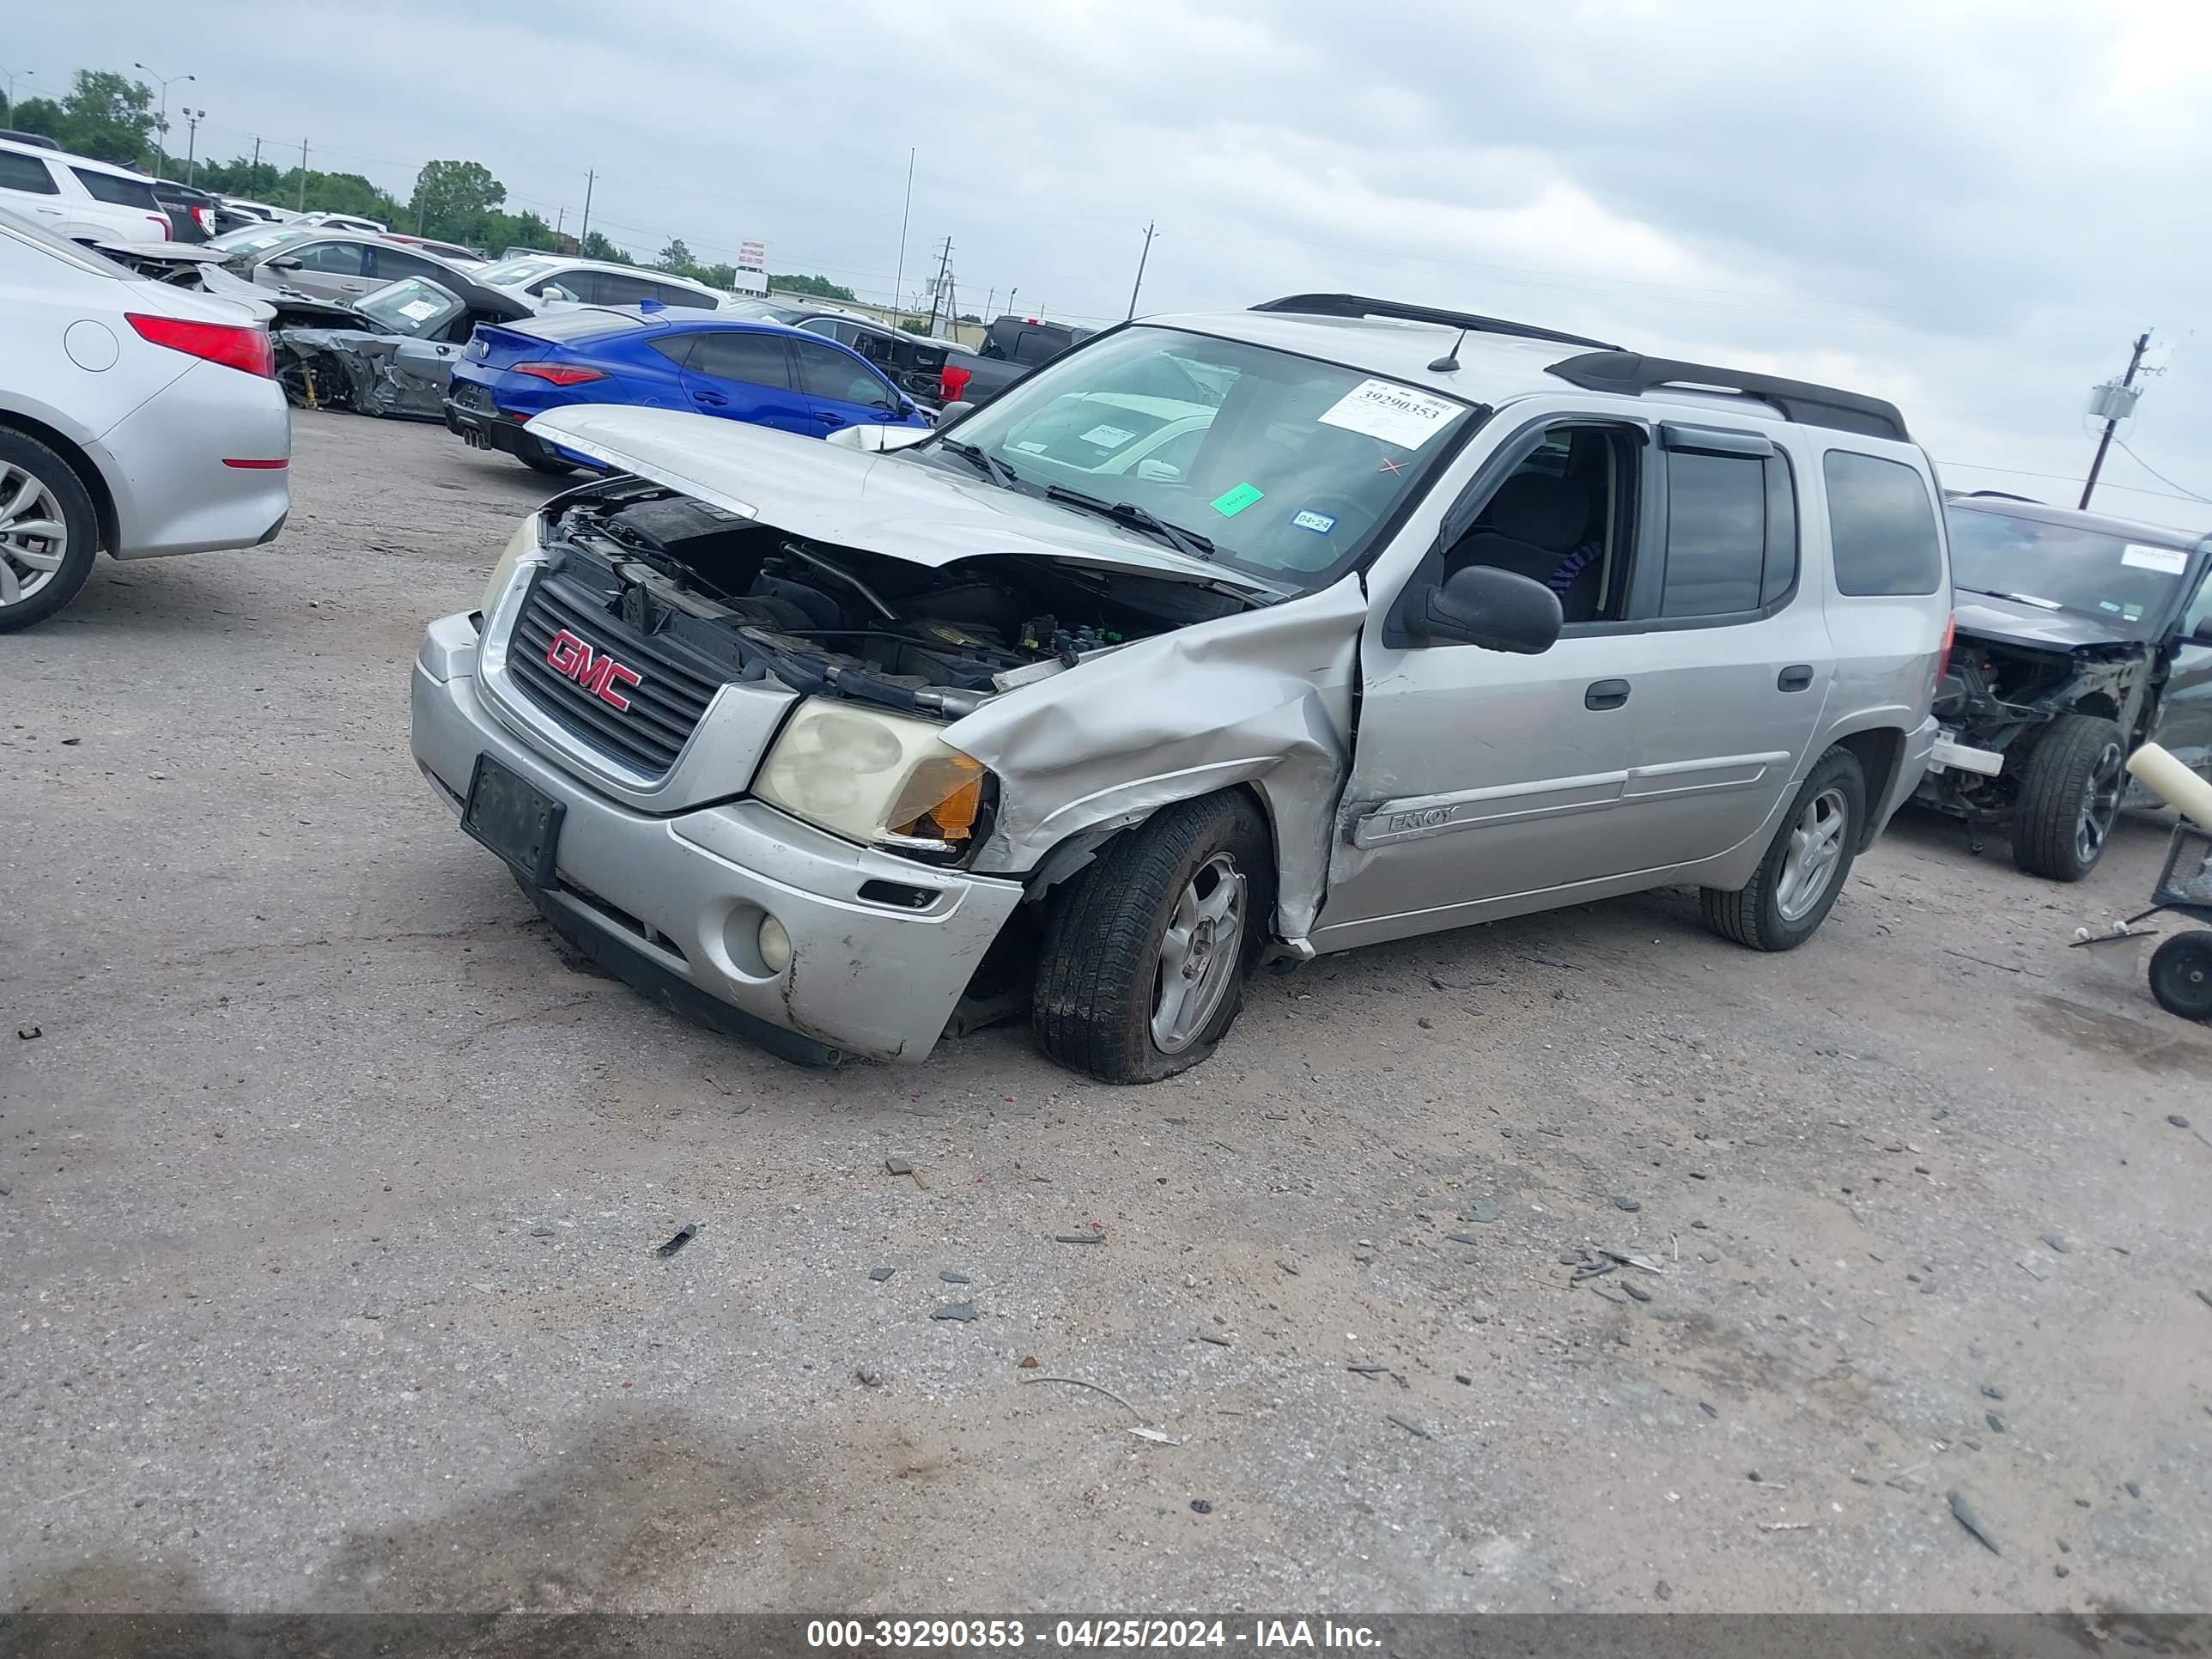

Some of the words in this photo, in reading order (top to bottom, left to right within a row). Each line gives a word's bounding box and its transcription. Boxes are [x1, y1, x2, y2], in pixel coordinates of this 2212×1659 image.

[1358, 390, 1440, 420] 39290353
[1226, 493, 1248, 507] TOTAL
[547, 629, 643, 713] GMC
[1389, 805, 1460, 831] ENVOY
